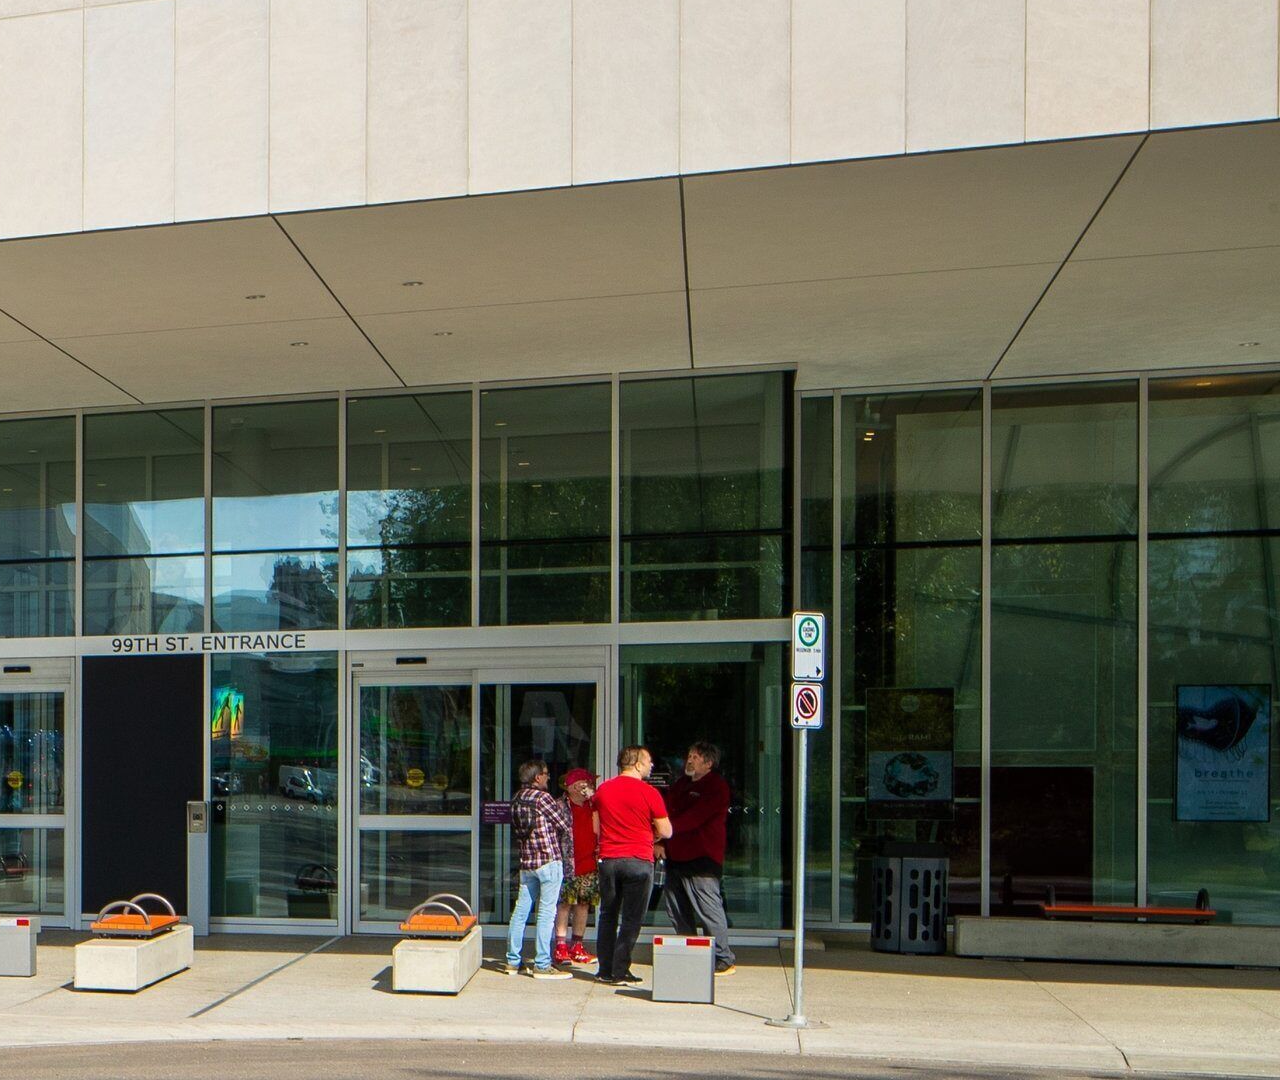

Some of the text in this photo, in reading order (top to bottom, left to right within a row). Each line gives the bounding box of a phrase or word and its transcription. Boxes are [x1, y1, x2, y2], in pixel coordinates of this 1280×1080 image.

[111, 633, 306, 653] 99TH ST. ENTRANCE
[1194, 767, 1254, 778] breathe
